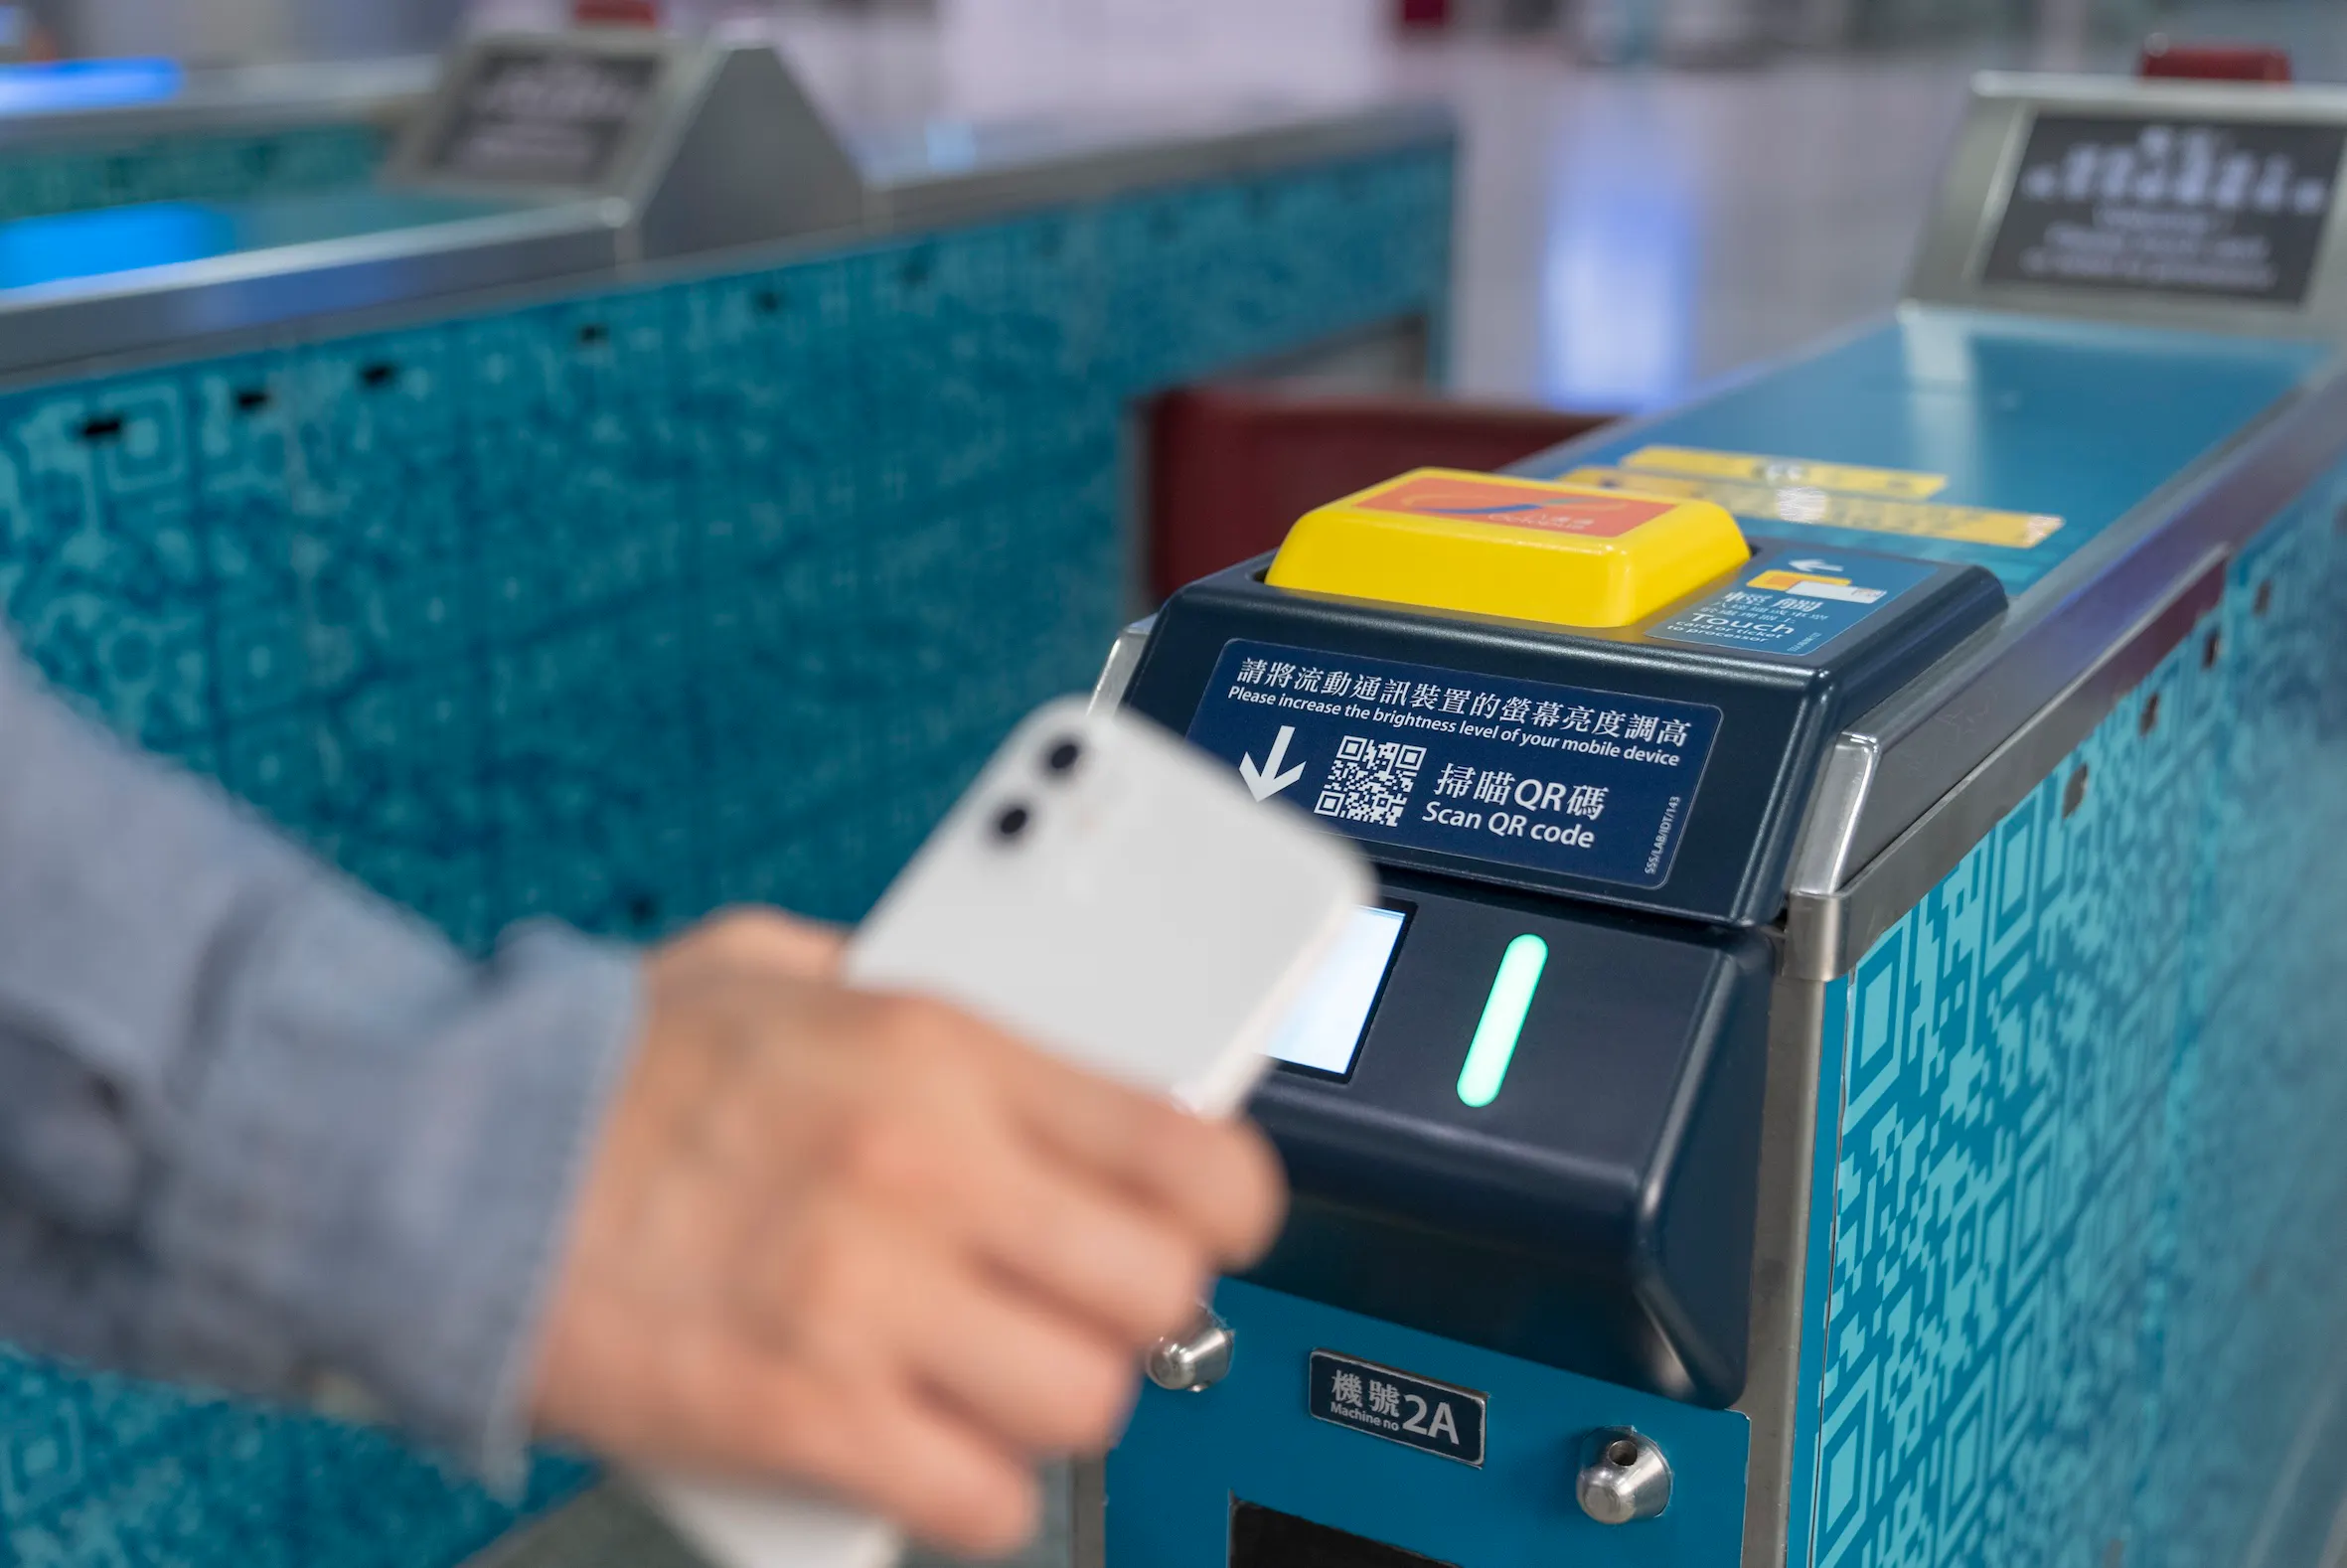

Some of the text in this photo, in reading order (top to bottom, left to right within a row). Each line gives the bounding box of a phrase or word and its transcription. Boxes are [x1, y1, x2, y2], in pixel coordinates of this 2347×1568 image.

[1675, 620, 1715, 630] card
[1736, 628, 1785, 639] ticket
[1685, 629, 1770, 643] processor
[1691, 612, 1796, 635] Touch
[1227, 686, 1680, 766] Please increase the brightness level of your mobile device
[1236, 657, 1692, 747] 請將流動通訊裝置的螢幕亮度調高
[1433, 762, 1610, 821] 掃瞄QR碼
[1422, 801, 1596, 849] Scan QR code
[1643, 795, 1681, 875] SSS/LAB/IDT/143
[1330, 1369, 1460, 1446] 機號 2A
[1330, 1401, 1400, 1432] Machine no
